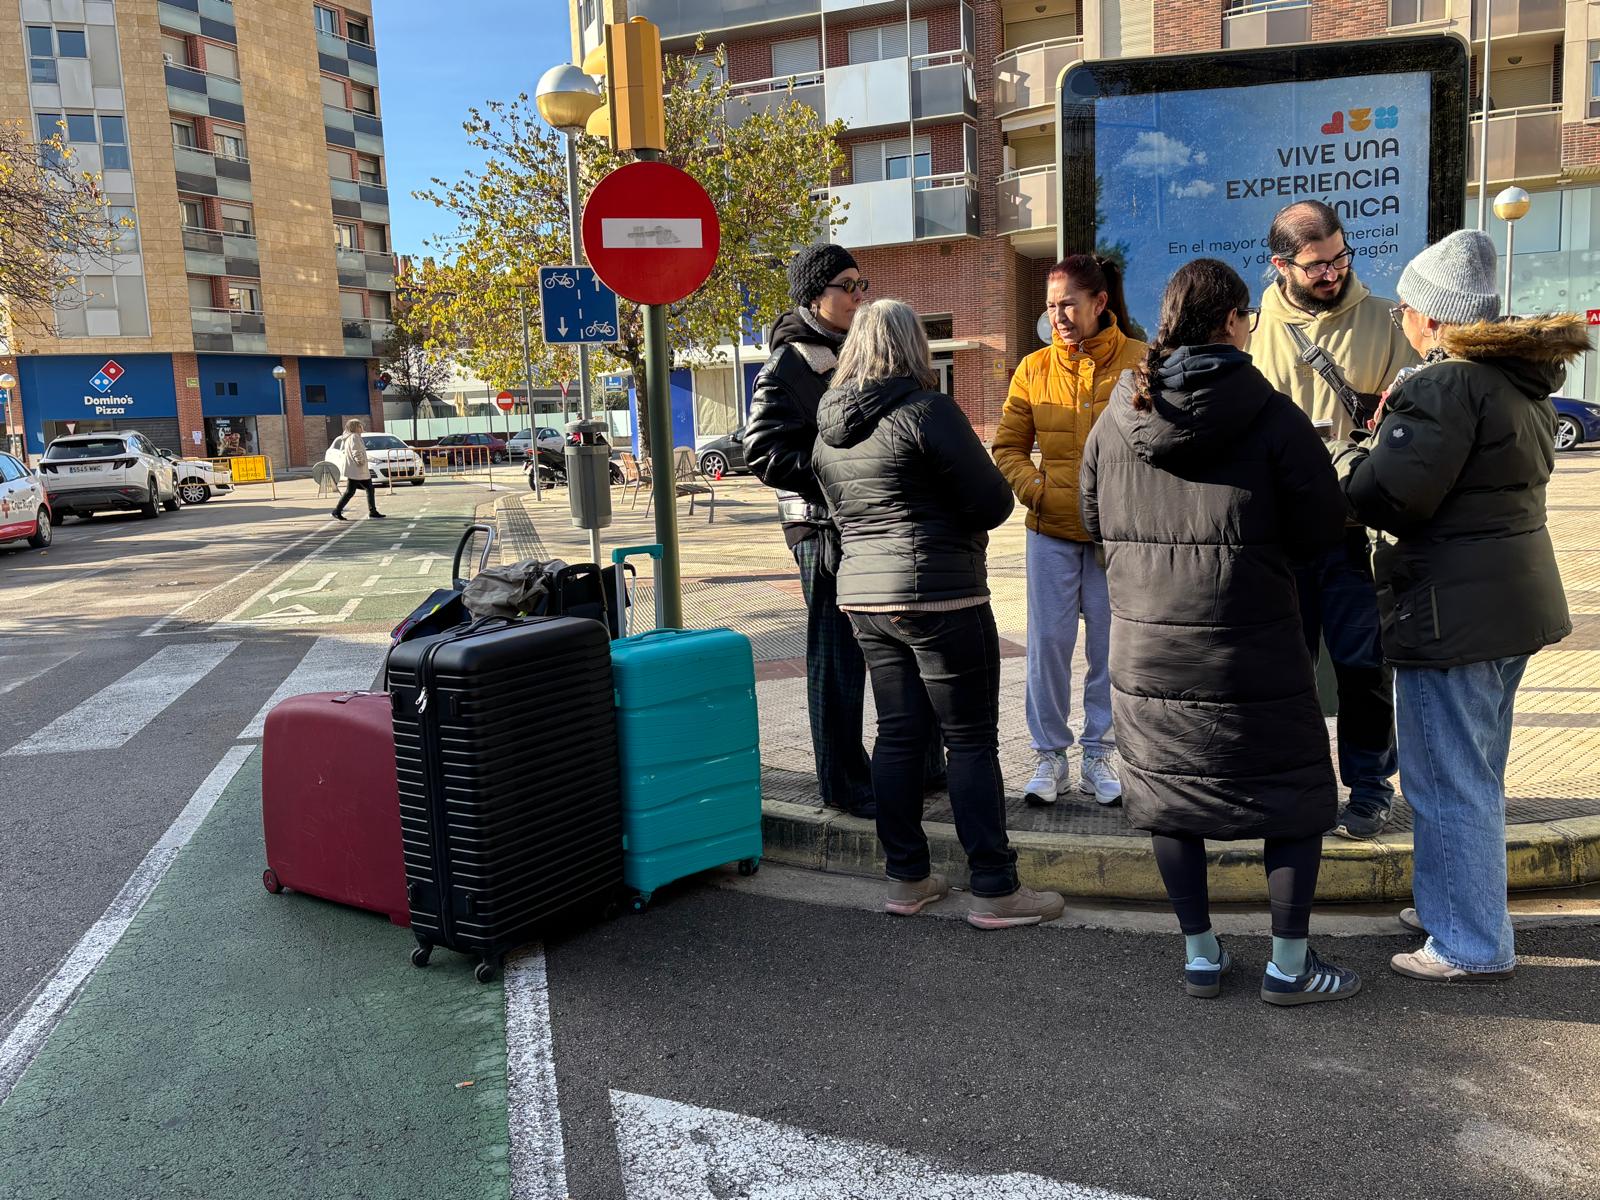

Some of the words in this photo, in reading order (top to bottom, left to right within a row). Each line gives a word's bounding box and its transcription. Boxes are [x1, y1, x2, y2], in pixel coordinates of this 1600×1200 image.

[1277, 144, 1335, 167] VIVE
[1345, 138, 1399, 161] UNA
[1227, 167, 1399, 199] EXPERIENCIA
[1322, 195, 1399, 218] NICA
[1169, 242, 1187, 254] En
[1192, 240, 1204, 252] el
[1209, 238, 1256, 253] mayor
[1242, 255, 1251, 268] y
[1354, 241, 1398, 258] ragón
[84, 394, 134, 405] Domino's
[95, 405, 125, 415] Pizza
